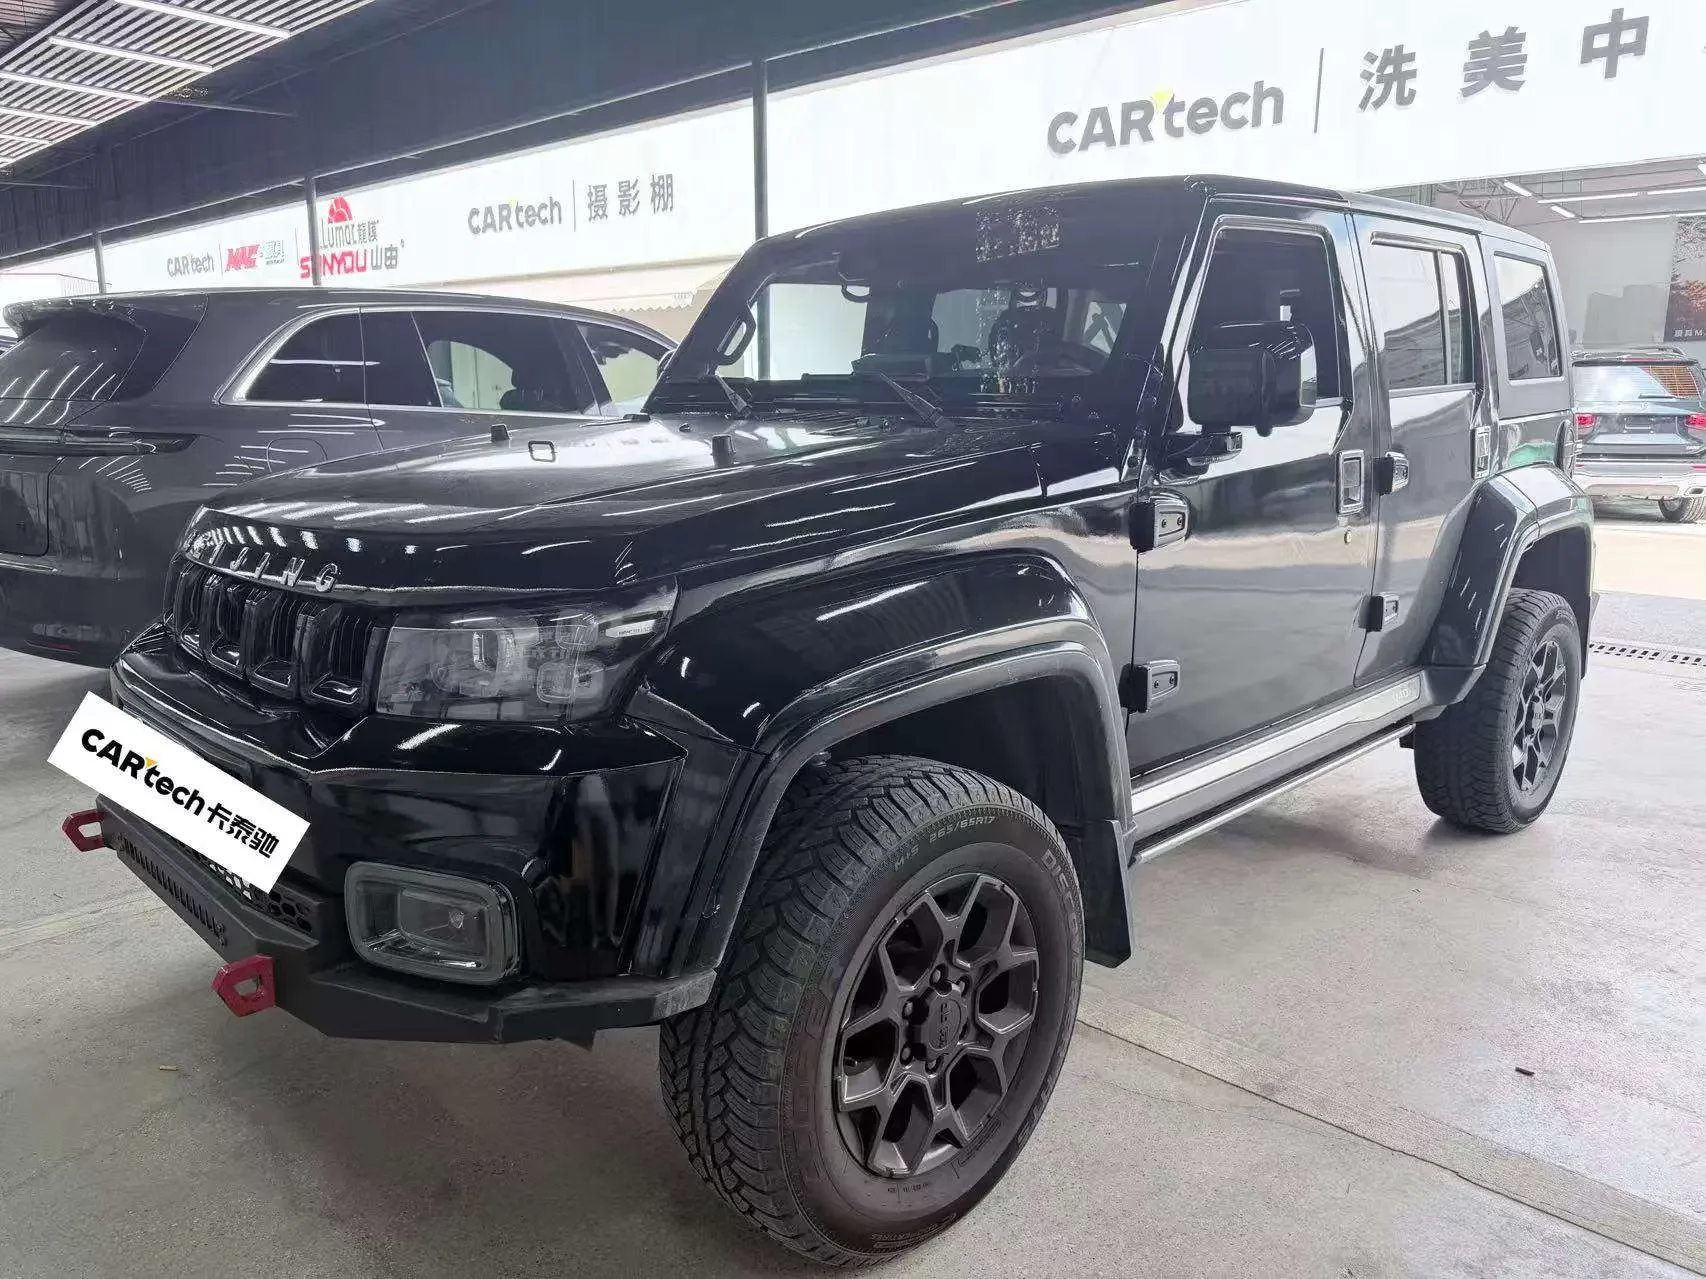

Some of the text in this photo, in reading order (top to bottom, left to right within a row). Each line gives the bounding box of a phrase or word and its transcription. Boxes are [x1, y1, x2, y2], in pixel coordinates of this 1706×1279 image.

[1047, 7, 1706, 155] CARtech 洗美中
[468, 173, 674, 234] CARtech 摄影棚
[167, 252, 215, 277] CARtech
[300, 248, 367, 279] SNYOU
